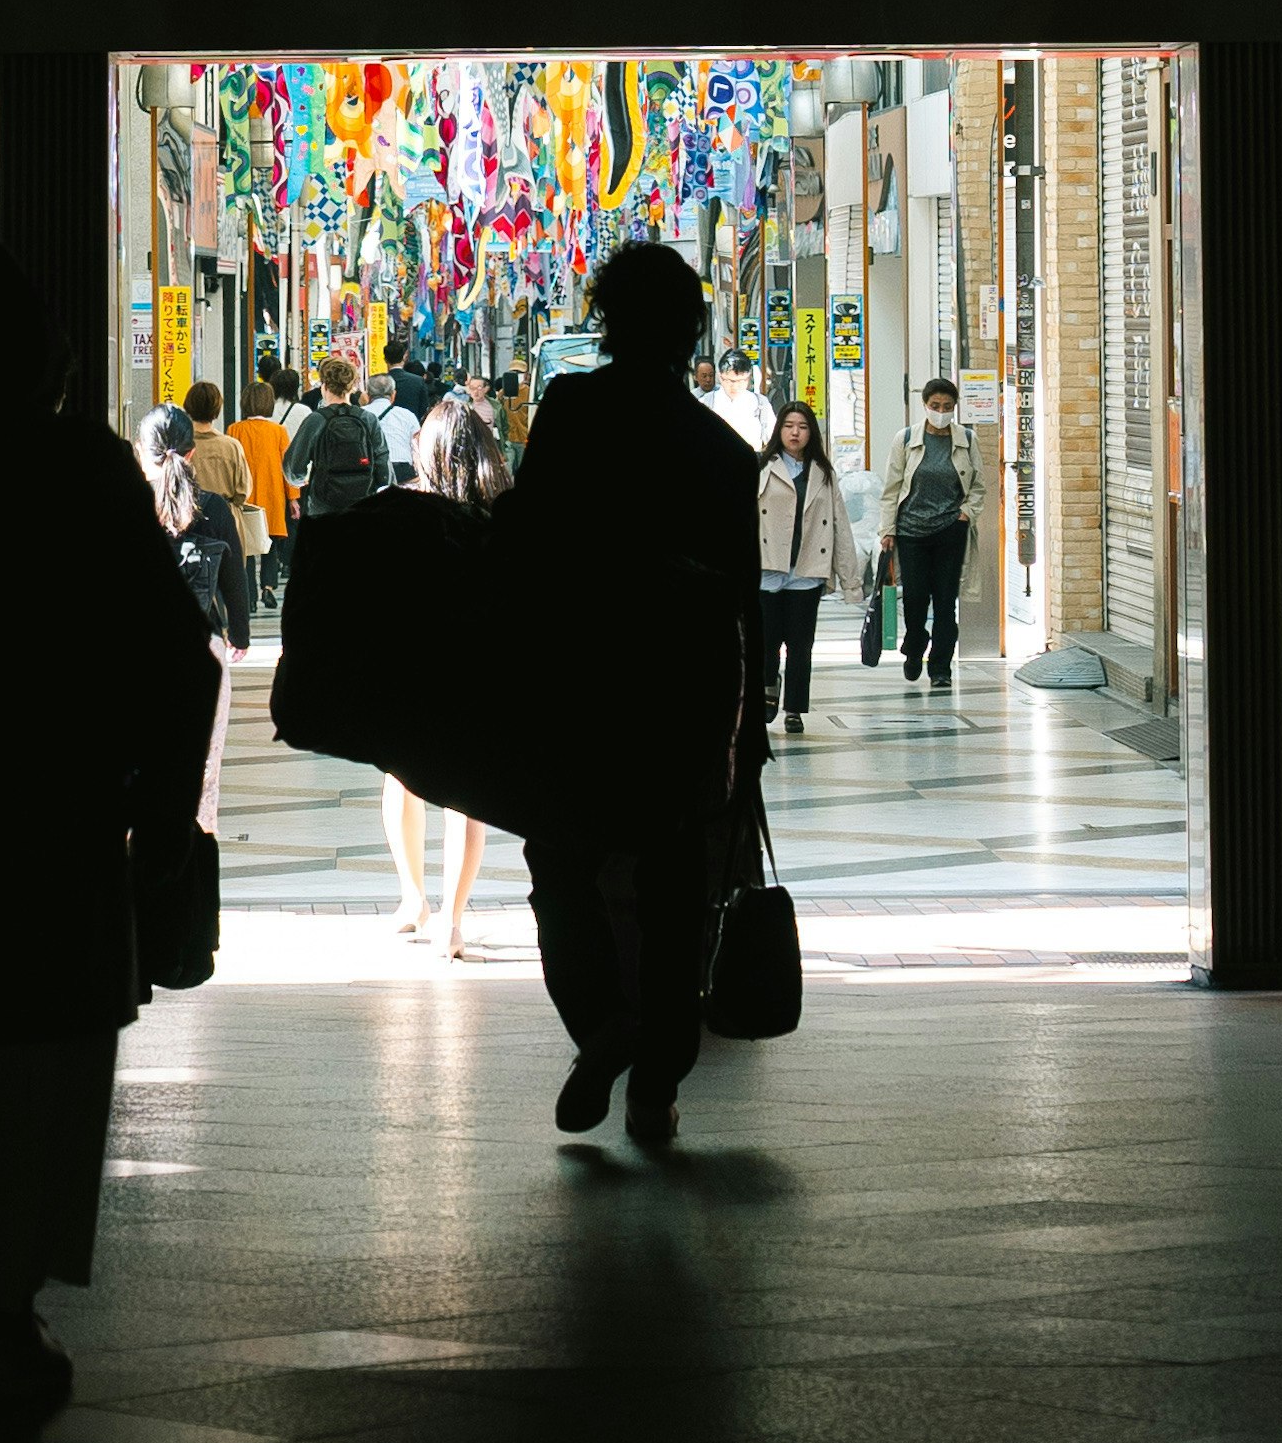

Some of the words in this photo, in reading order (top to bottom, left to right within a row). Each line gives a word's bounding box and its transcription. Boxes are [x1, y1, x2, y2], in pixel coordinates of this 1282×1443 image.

[133, 333, 154, 345] TAX
[175, 291, 188, 355] 自転車から
